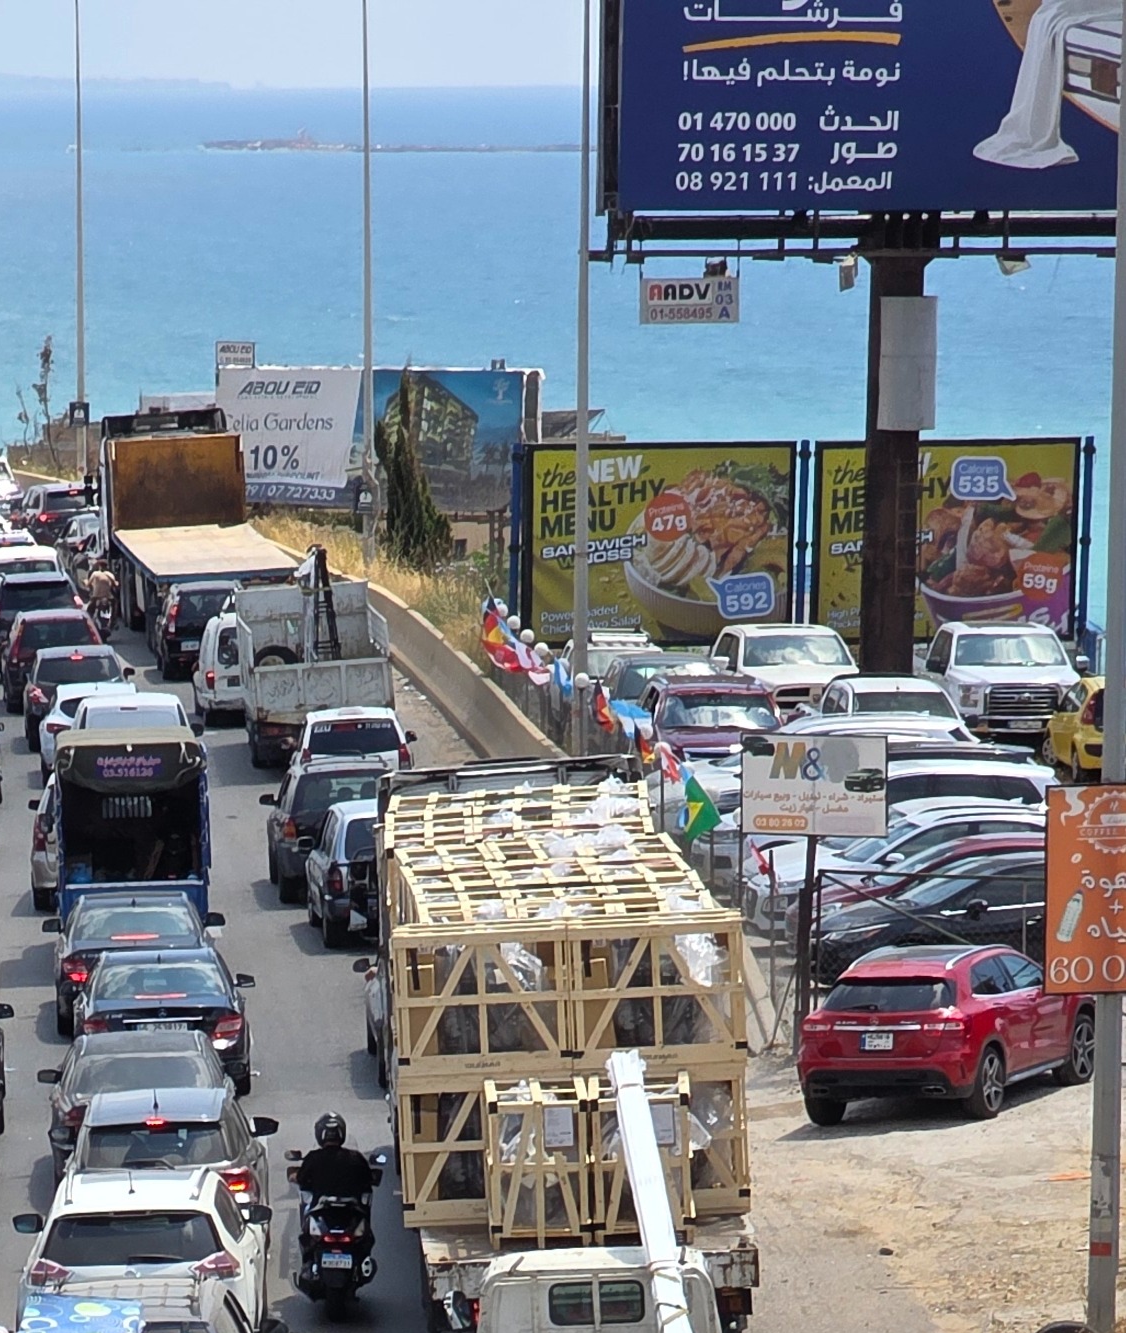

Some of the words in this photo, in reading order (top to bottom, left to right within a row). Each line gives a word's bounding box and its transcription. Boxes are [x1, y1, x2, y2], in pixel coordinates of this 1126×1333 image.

[683, 0, 903, 28] فرشات
[683, 58, 751, 85] فيها!
[756, 58, 835, 87] بتحلم
[842, 60, 901, 87] نومة
[678, 112, 703, 131] 01
[710, 112, 751, 131] 470
[756, 112, 797, 131] 000
[819, 105, 899, 131] الحدث
[677, 143, 704, 162] 70
[710, 143, 736, 162] 16
[742, 143, 767, 162] 15
[772, 143, 800, 162] 37
[830, 141, 898, 165] صور
[675, 171, 703, 191] 08
[710, 171, 749, 191] 921
[759, 171, 797, 191] 111
[808, 171, 892, 194] المعمل:
[718, 306, 730, 319] A
[238, 381, 290, 396] ABOU
[292, 381, 321, 395] EID
[263, 411, 334, 432] Gardens
[250, 444, 300, 471] 10%
[542, 463, 577, 488] the
[587, 454, 643, 484] NEW
[267, 486, 287, 498] 07
[958, 475, 999, 493] 535
[540, 509, 616, 540] MENU
[651, 514, 688, 532] 47g
[724, 581, 767, 593] Calories
[1023, 573, 1057, 594] 59g
[587, 605, 618, 618] oaded
[726, 592, 768, 612] 592
[611, 615, 641, 628] Salad
[1081, 869, 1126, 898] هوة
[1087, 916, 1126, 943] ياه
[1049, 956, 1094, 984] 60
